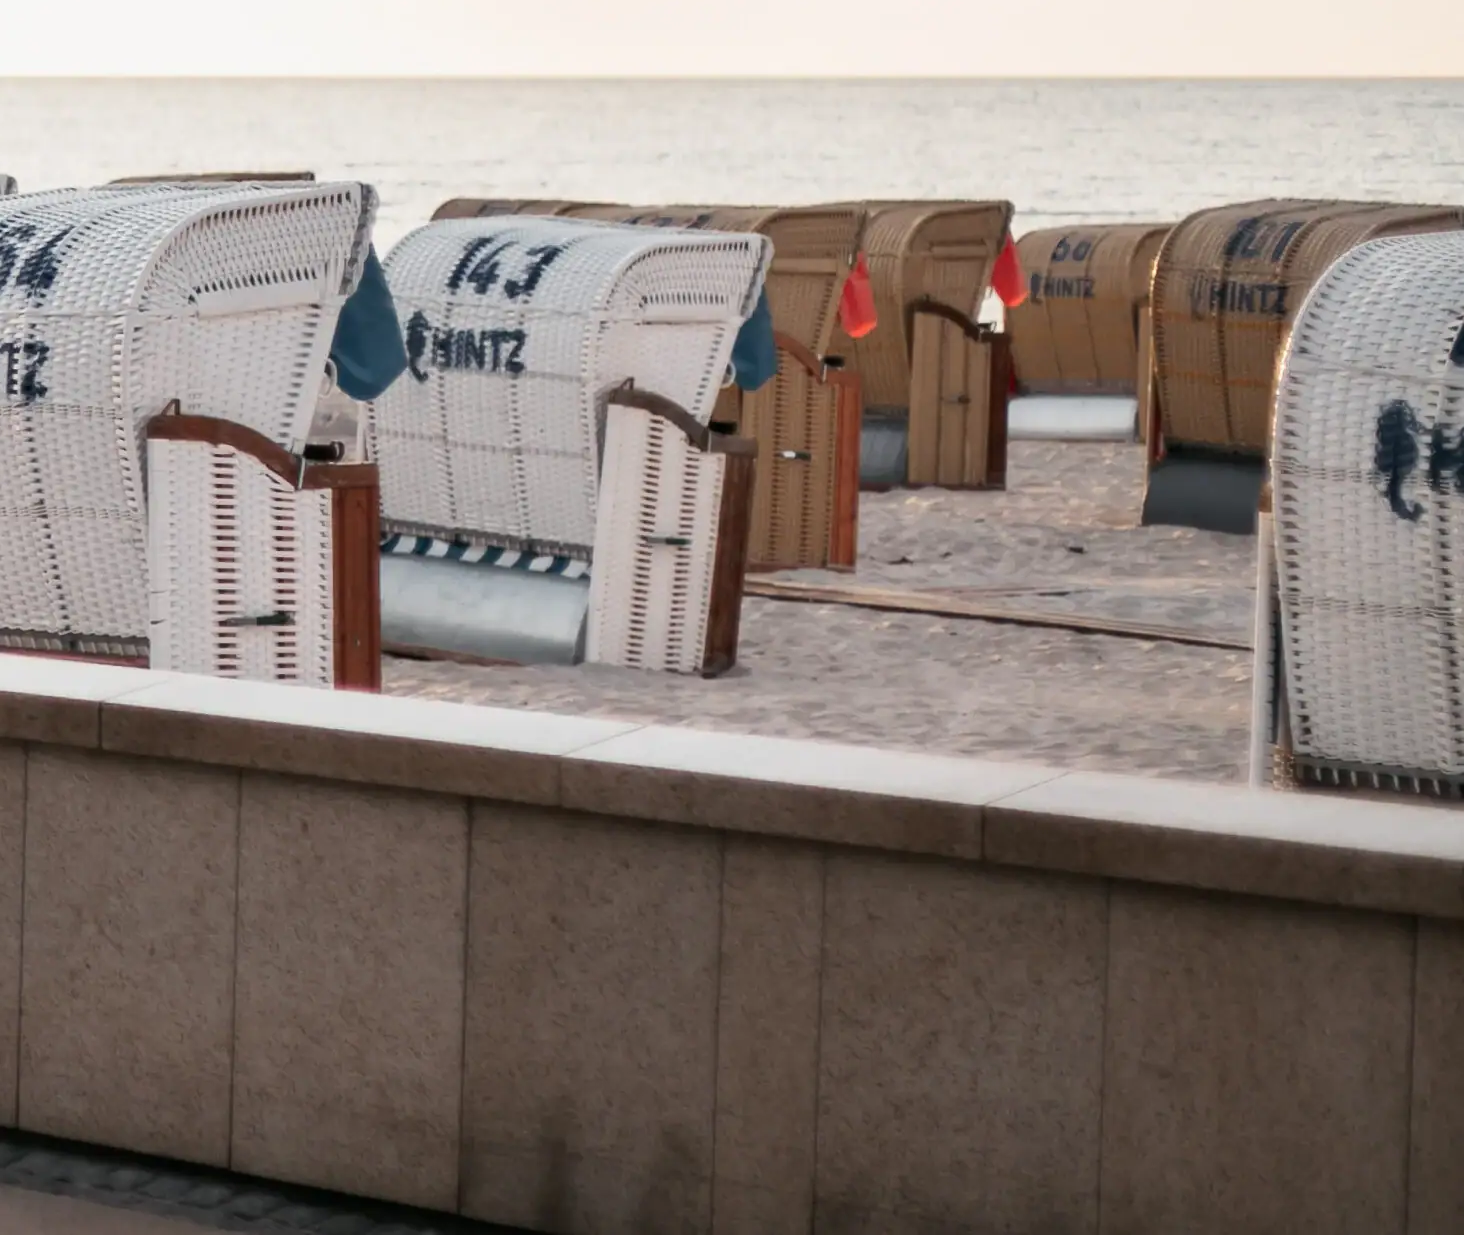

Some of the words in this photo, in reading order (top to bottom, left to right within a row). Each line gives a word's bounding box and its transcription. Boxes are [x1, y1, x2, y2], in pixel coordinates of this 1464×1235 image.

[1044, 276, 1095, 299] HINTZ
[1209, 280, 1289, 316] HINTZ
[432, 325, 526, 374] HINTZ
